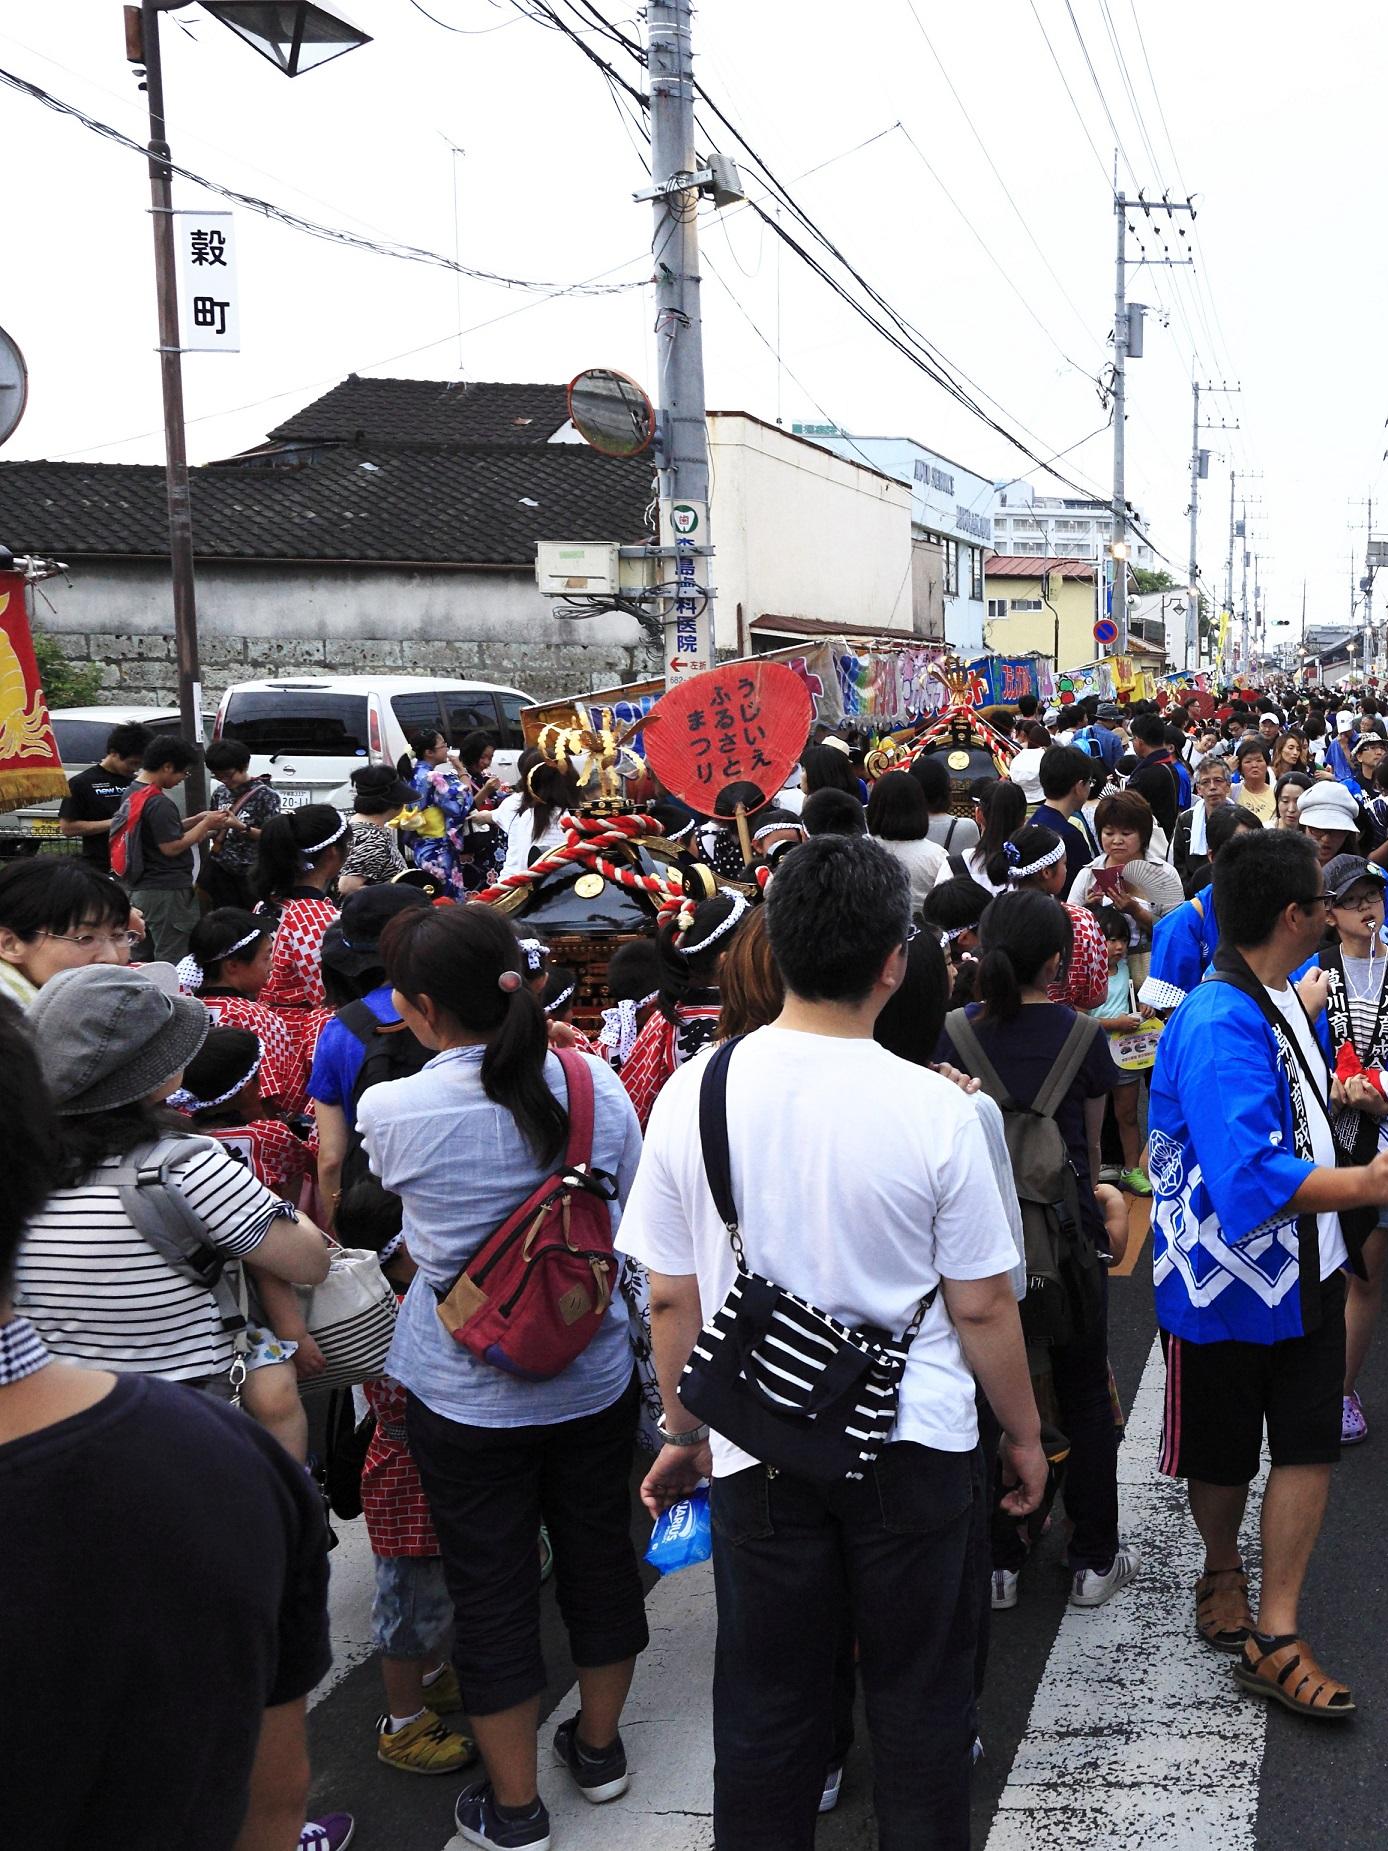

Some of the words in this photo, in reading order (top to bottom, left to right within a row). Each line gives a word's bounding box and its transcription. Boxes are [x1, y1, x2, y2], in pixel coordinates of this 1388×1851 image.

[190, 229, 231, 335] 穀町
[687, 709, 714, 784] まつり
[709, 686, 743, 778] ふるさと
[737, 677, 772, 769] うじいえ
